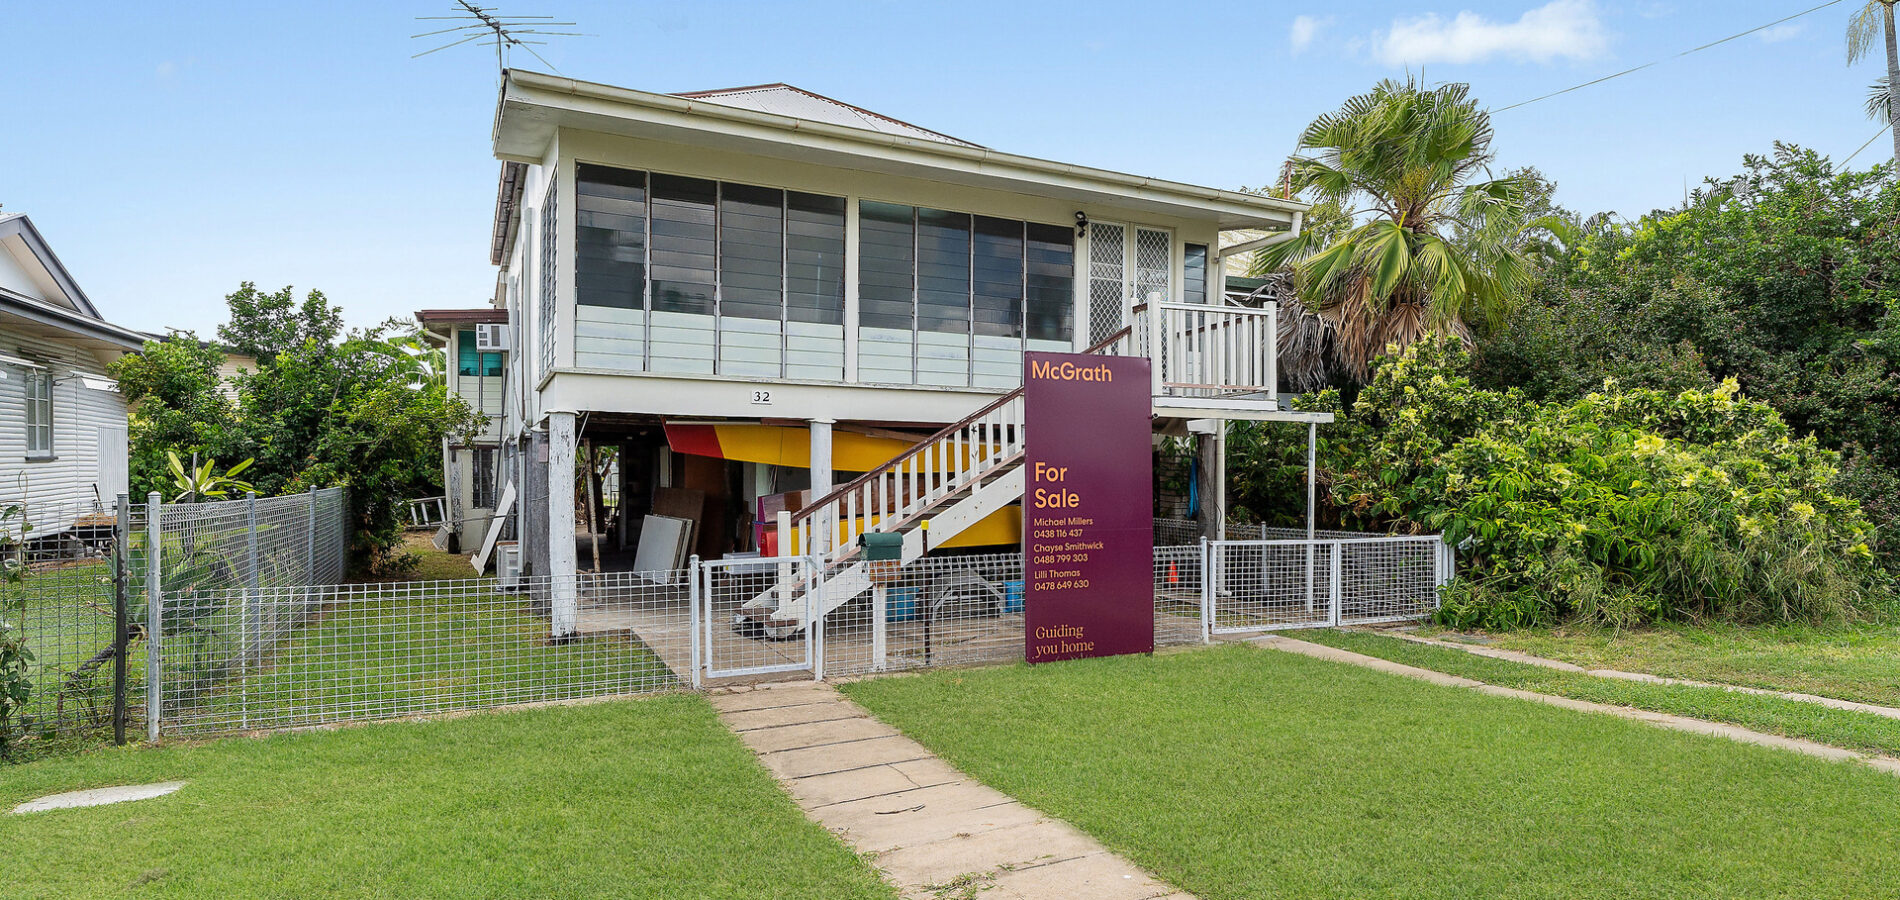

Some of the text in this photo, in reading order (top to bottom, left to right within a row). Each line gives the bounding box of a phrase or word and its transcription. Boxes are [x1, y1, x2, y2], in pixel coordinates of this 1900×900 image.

[1032, 360, 1112, 382] McGrath
[753, 391, 770, 402] 32
[1035, 461, 1068, 482] For
[1034, 488, 1080, 508] Sale
[1033, 517, 1093, 527] Michael Millers
[1033, 529, 1083, 538] 0438 116 437
[1033, 541, 1104, 553] Chayse Smithwick
[1033, 553, 1088, 564] 0488 799 303
[1034, 569, 1080, 579] Lilli Thomas
[1034, 579, 1089, 591] 0478 649 630
[1035, 624, 1084, 639] Guiding
[1034, 640, 1095, 658] you home
